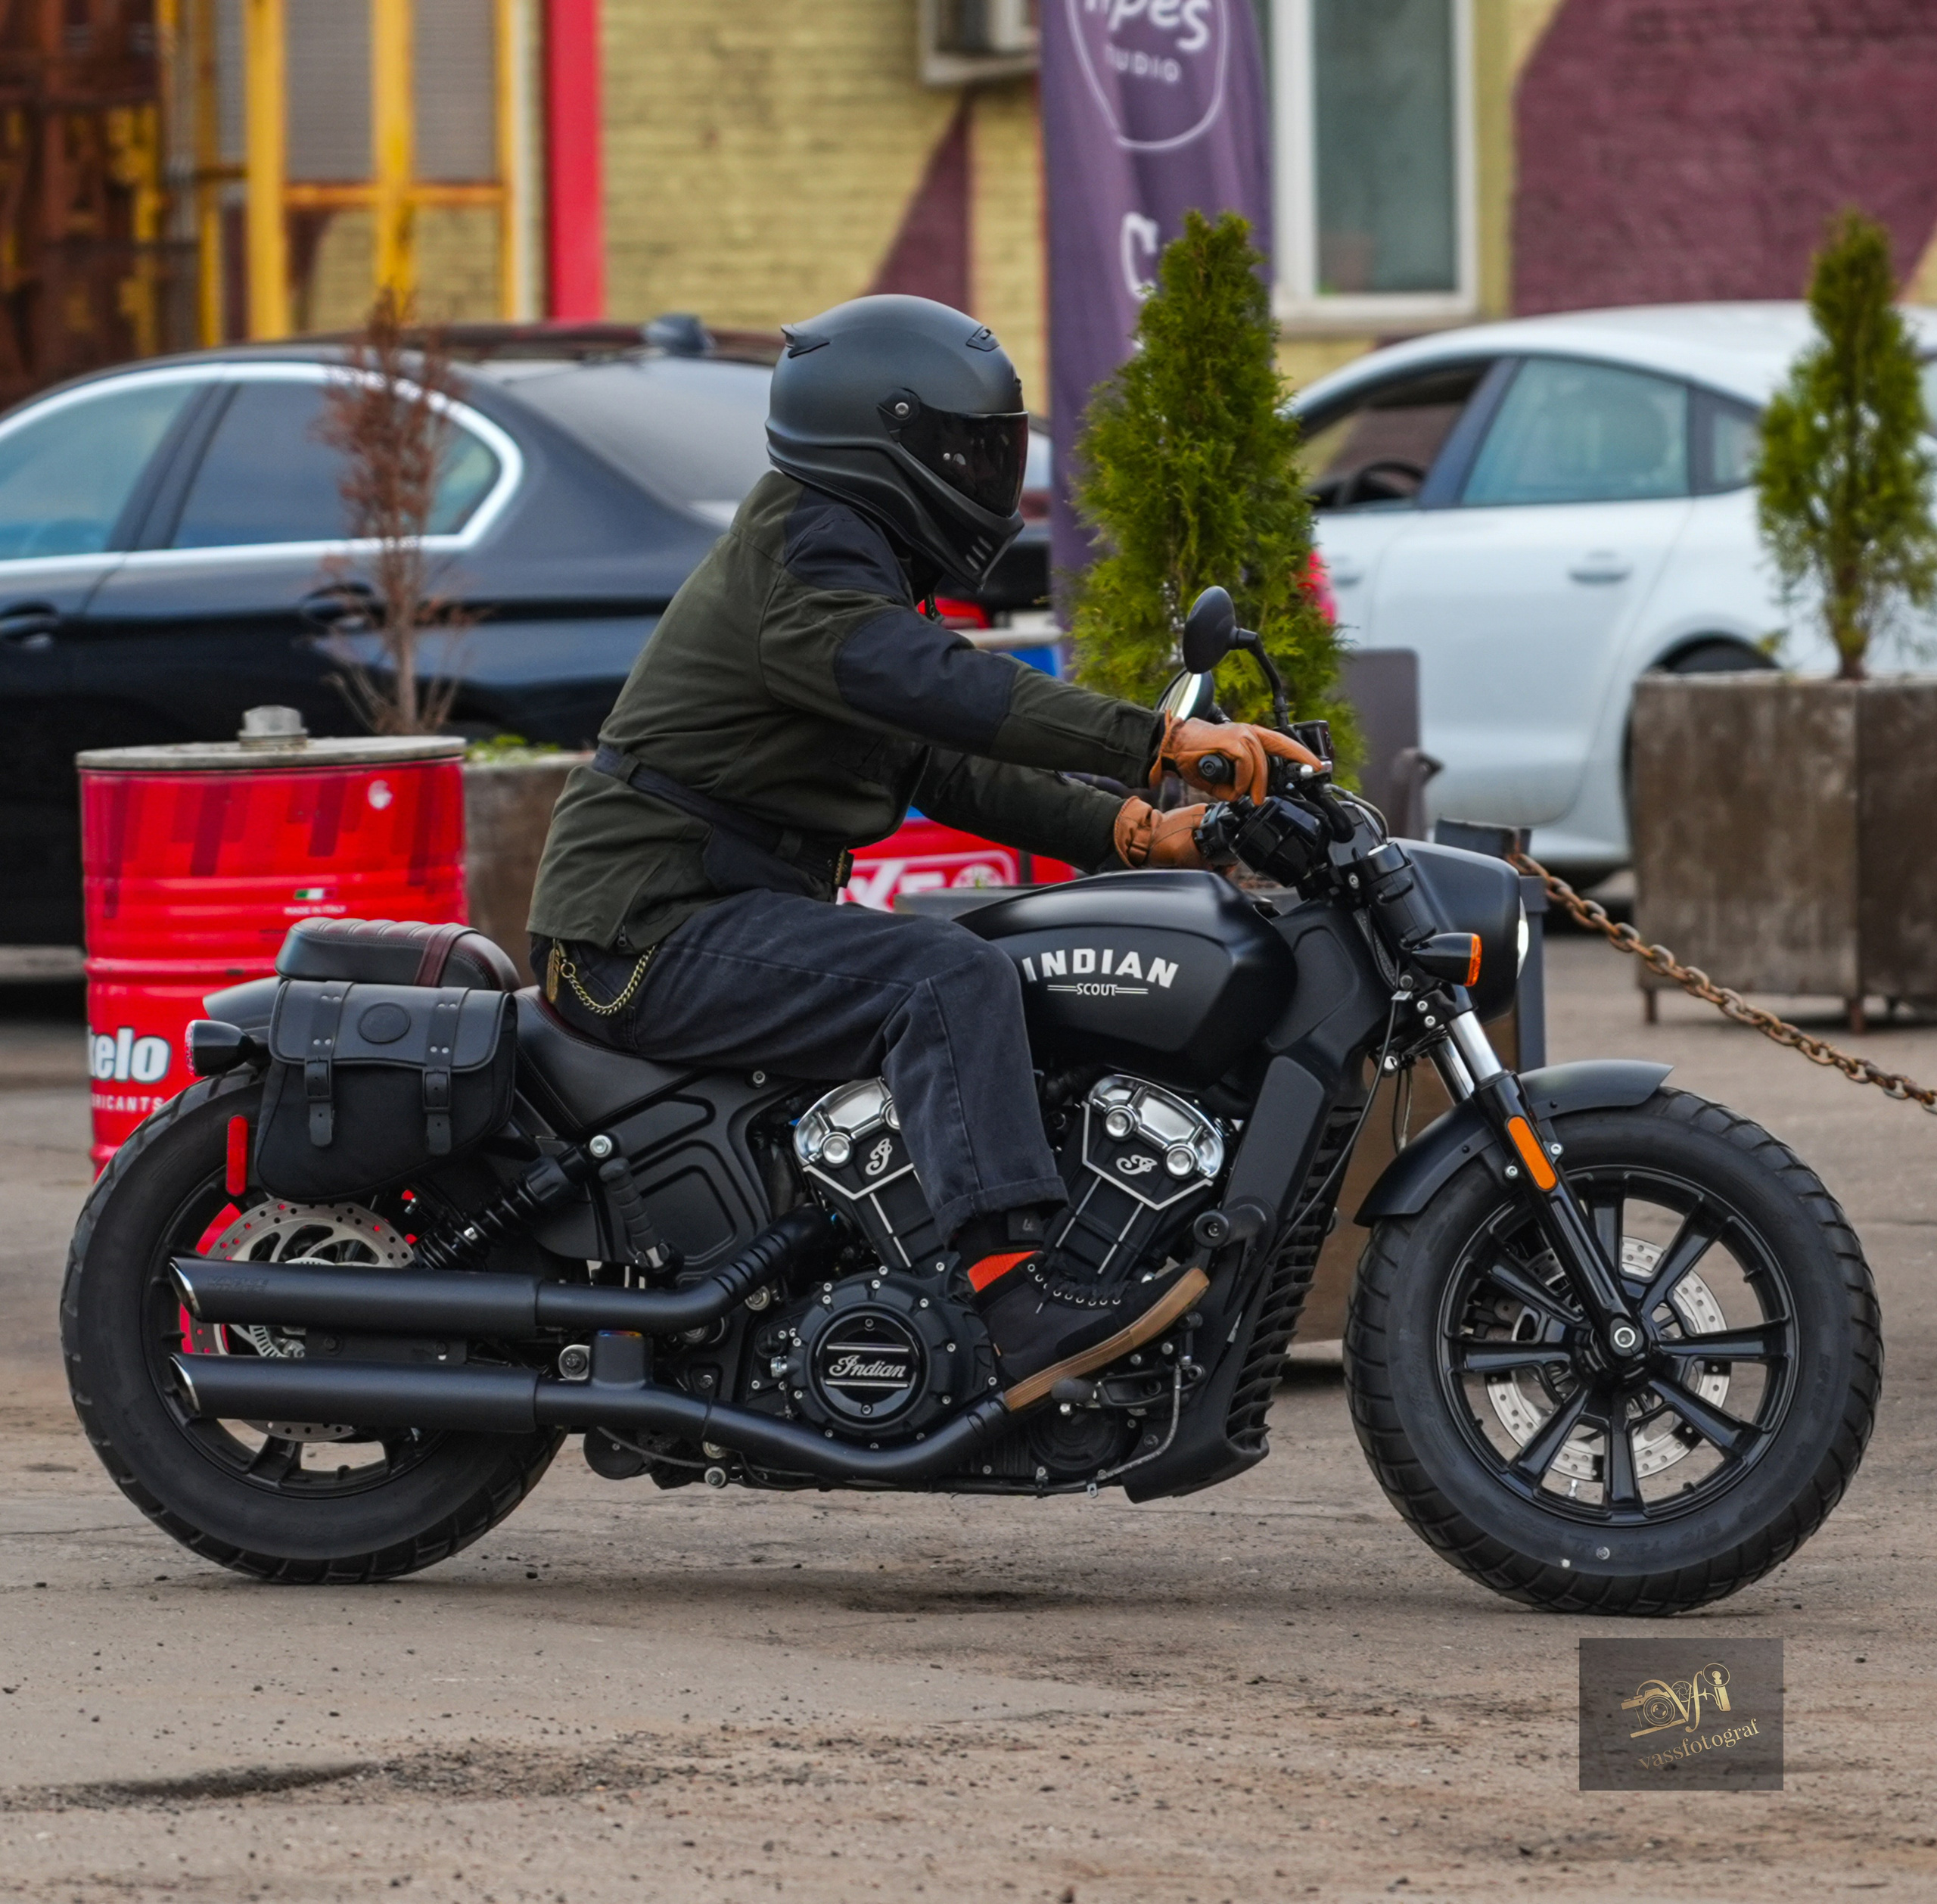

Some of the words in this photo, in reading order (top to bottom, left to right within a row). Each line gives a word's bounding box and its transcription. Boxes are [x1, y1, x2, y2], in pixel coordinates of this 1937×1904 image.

[1022, 948, 1179, 988] INDIAN
[1077, 983, 1118, 996] SCOUT
[87, 1025, 171, 1084] elo
[829, 1355, 906, 1377] Indian
